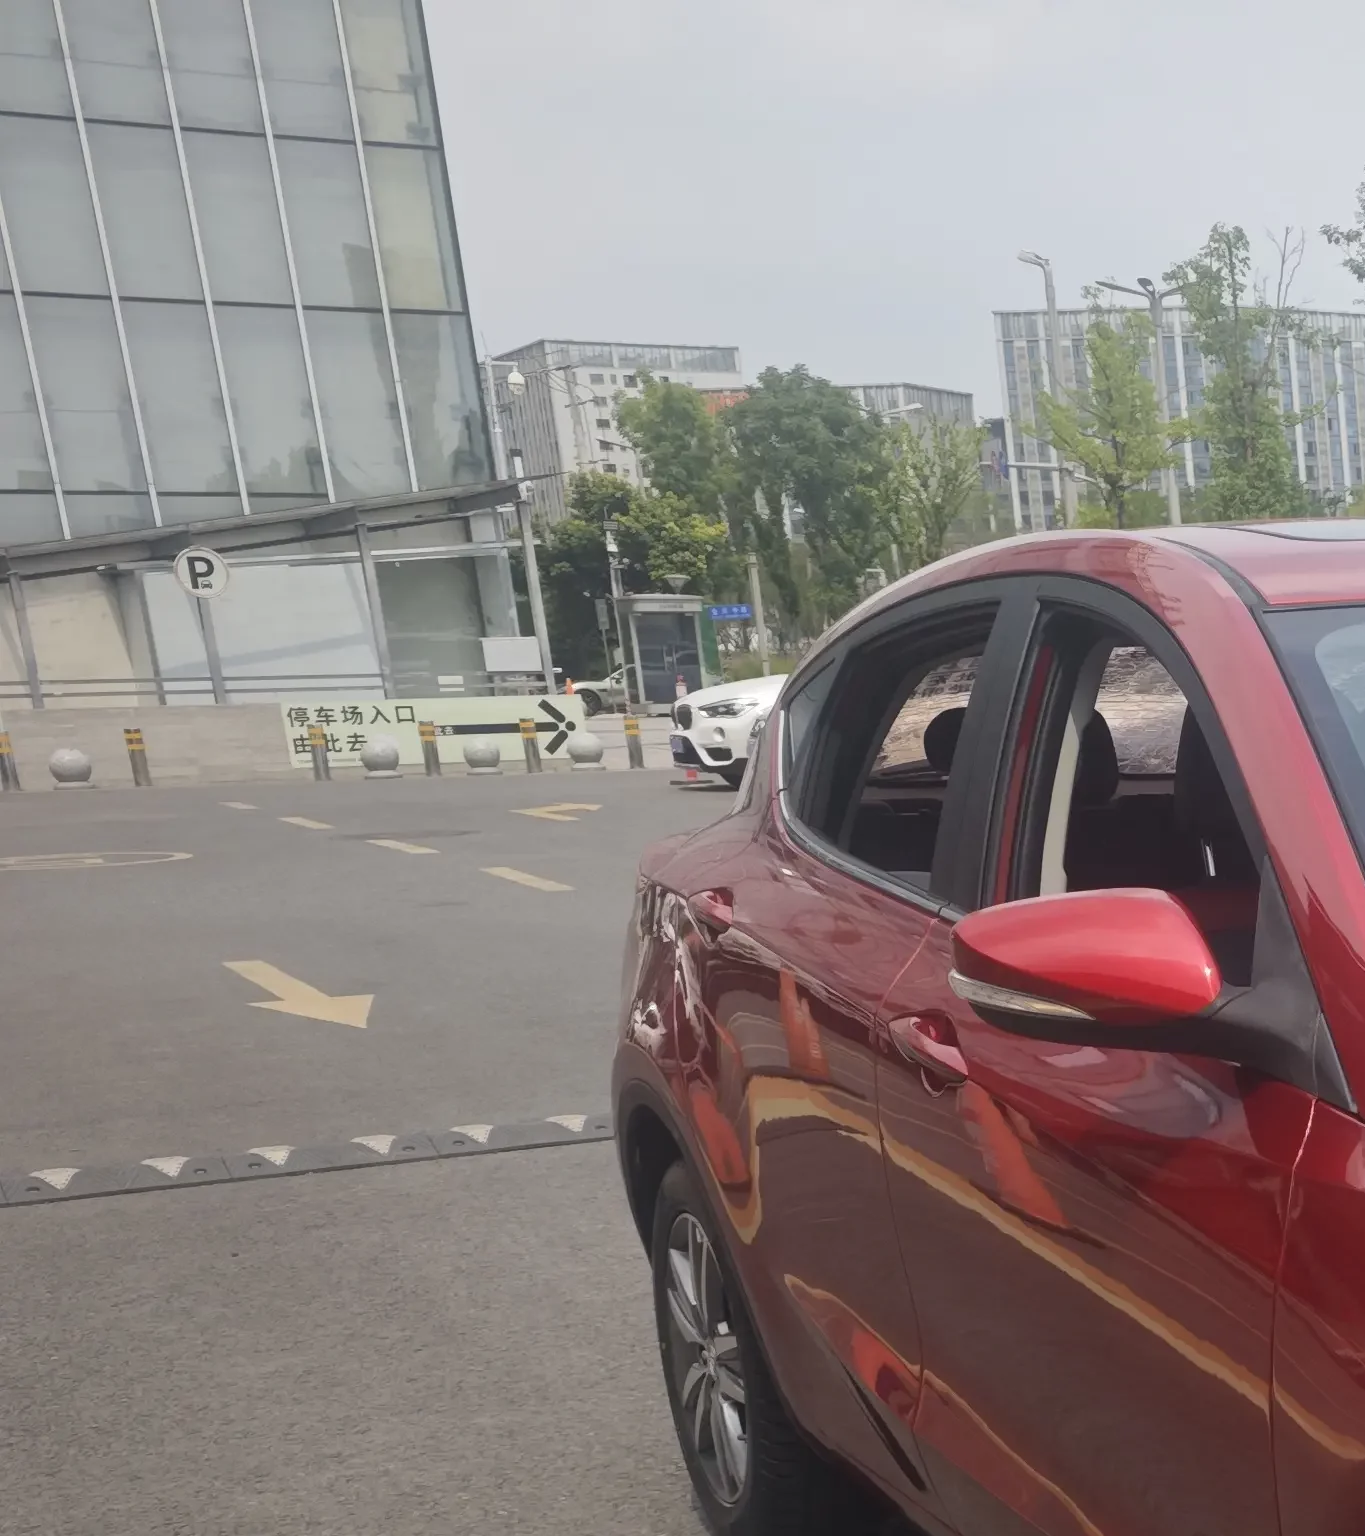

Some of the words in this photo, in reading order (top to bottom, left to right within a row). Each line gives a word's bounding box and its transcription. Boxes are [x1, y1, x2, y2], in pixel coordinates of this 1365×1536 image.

[186, 556, 214, 589] P
[287, 705, 416, 727] 停车场入口
